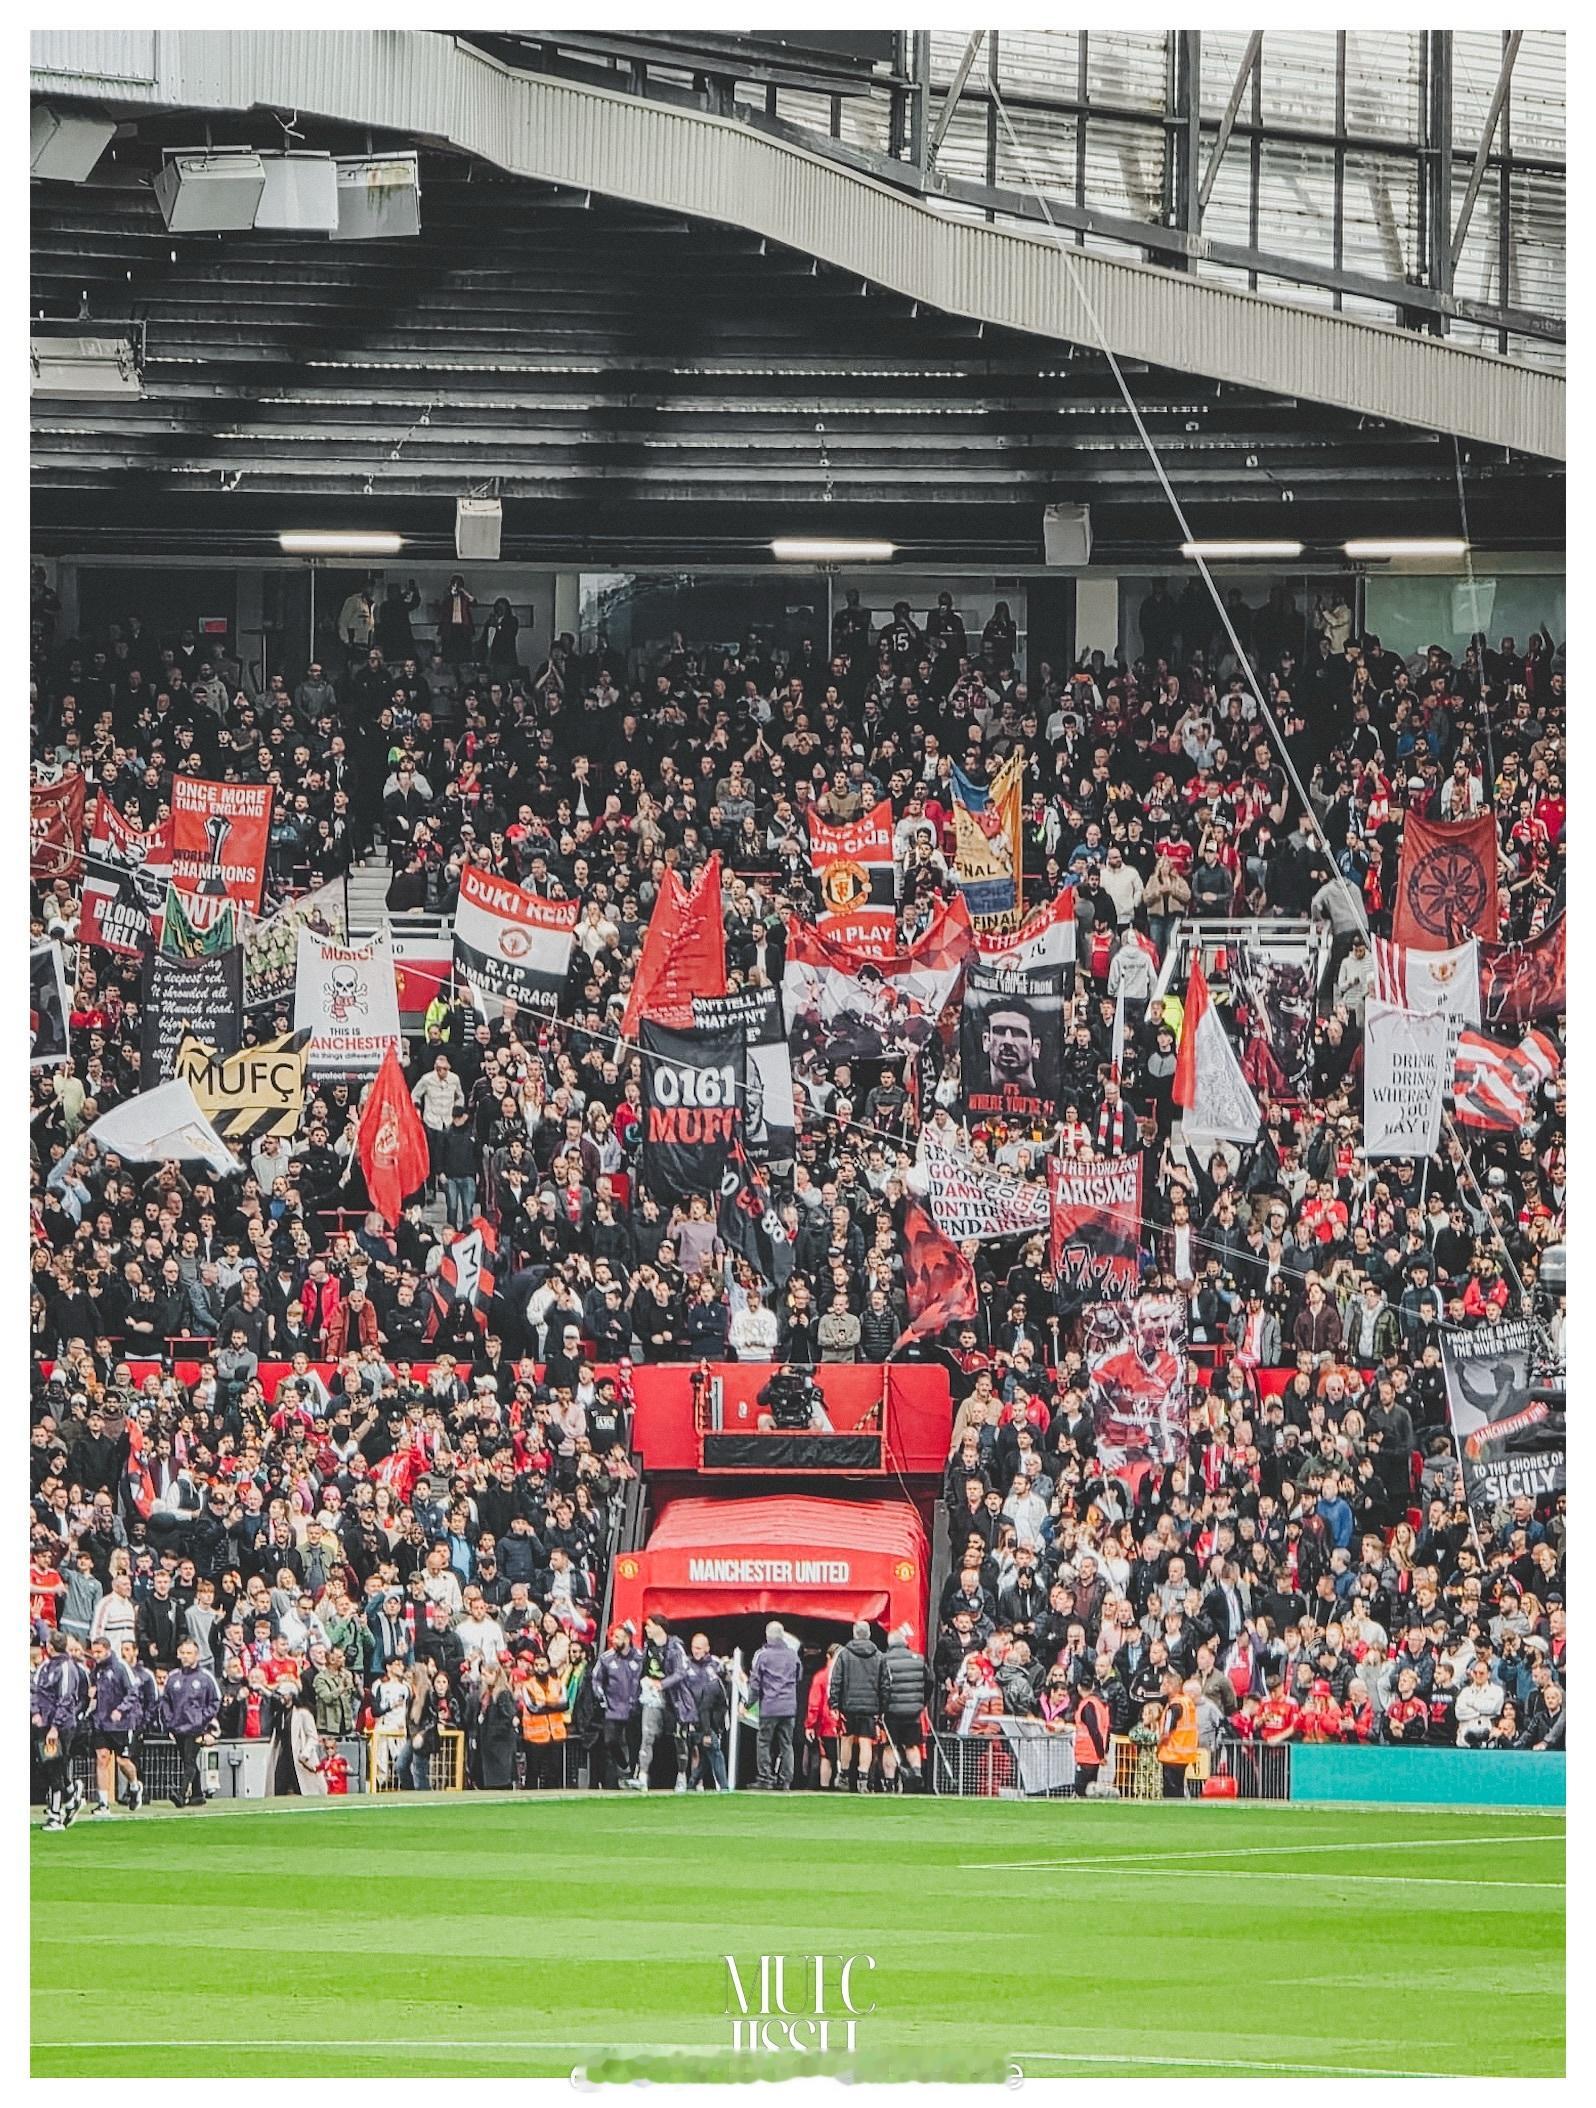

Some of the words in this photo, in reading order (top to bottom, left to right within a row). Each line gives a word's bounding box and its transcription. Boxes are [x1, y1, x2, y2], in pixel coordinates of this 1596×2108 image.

[892, 632, 909, 652] 15
[175, 780, 218, 802] ONCE
[221, 788, 266, 805] MORE
[175, 796, 206, 813] THAN
[209, 802, 263, 817] ENGLAND
[171, 858, 257, 884] CHAMPIONS
[465, 873, 520, 915] DUKI
[93, 897, 151, 935] BLOODY
[972, 911, 1018, 929] FINAL
[101, 921, 138, 949] HELL
[845, 925, 892, 943] PLAY
[485, 958, 526, 983] R.I.P
[160, 999, 203, 1014] Munich
[691, 997, 723, 1012] ON'T
[724, 993, 756, 1010] TELL
[755, 987, 777, 1005] ME
[158, 1016, 182, 1032] befor
[330, 1027, 350, 1036] THIS
[352, 1027, 361, 1036] IS
[310, 1034, 399, 1052] ANCHESTER
[653, 1064, 736, 1107] 0161
[1052, 1158, 1119, 1177] STRETFORD
[1055, 1172, 1138, 1206] ARISING
[1452, 1341, 1473, 1358] THE
[1473, 1413, 1530, 1442] MANCHESTER
[1472, 1464, 1487, 1480] TO
[1487, 1460, 1509, 1477] THE
[1508, 1452, 1550, 1473] SHORES
[1484, 1466, 1557, 1502] SICILY
[689, 1557, 793, 1584] MANCHESTER
[794, 1559, 850, 1584] UNITED
